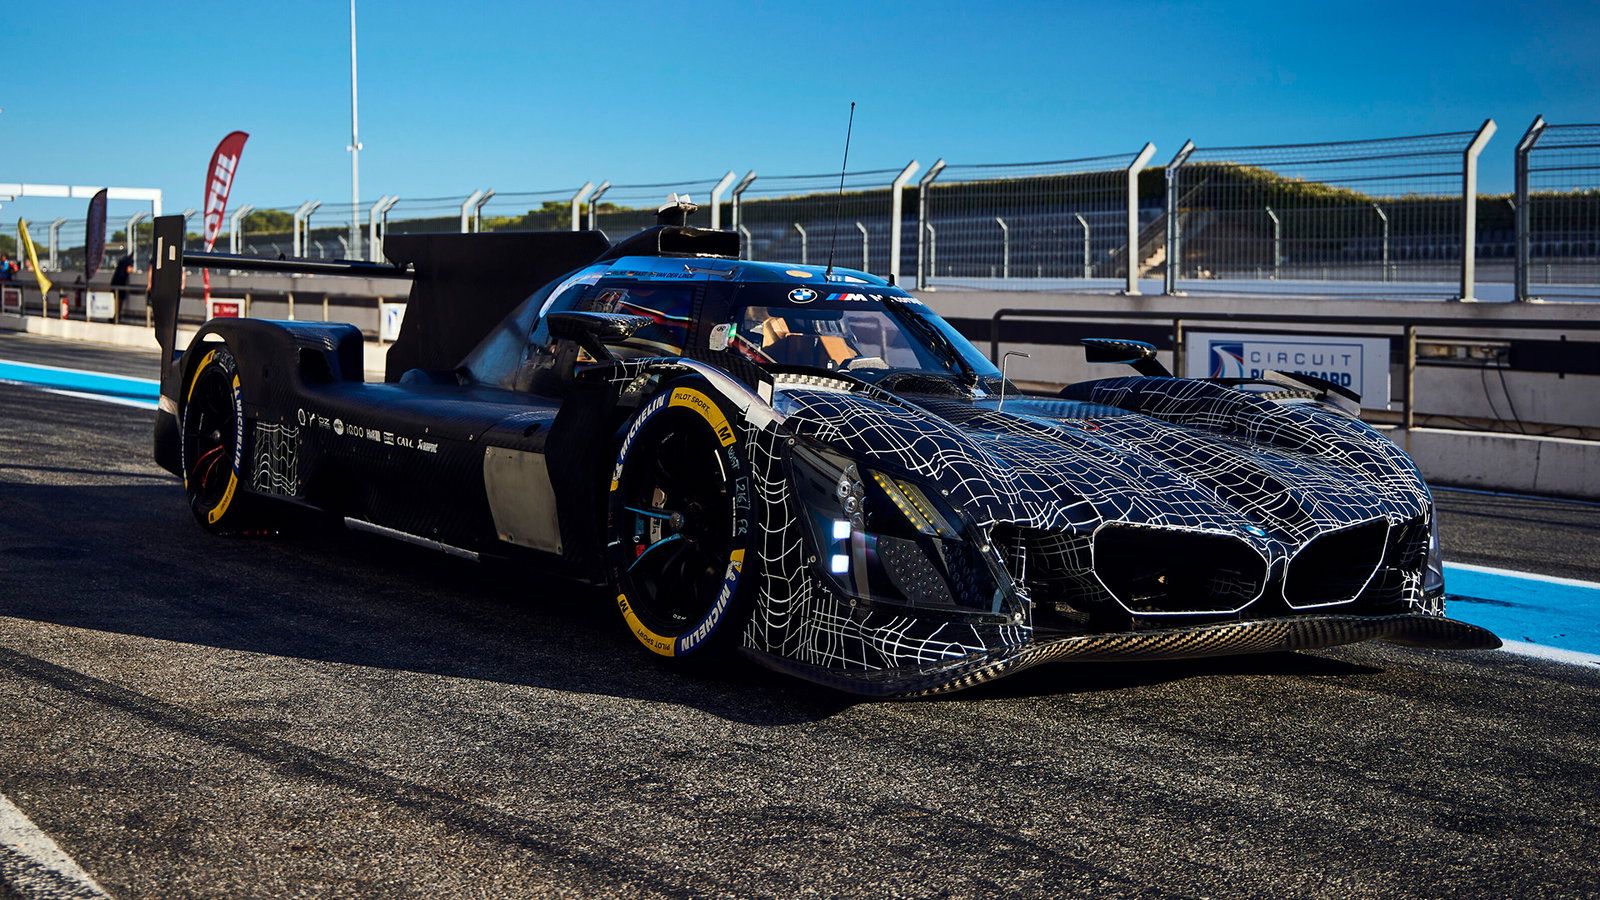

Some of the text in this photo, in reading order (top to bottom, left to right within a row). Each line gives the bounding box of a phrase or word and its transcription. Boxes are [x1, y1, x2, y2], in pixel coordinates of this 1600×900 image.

[1250, 351, 1352, 366] CIRCUIT
[1294, 370, 1352, 387] ARD
[674, 392, 710, 411] PILOT SPORT
[234, 400, 242, 468] MICHELIN
[620, 393, 666, 460] MICHELIN
[717, 425, 733, 442] M
[681, 583, 731, 652] MICHELIN
[637, 628, 671, 651] PILOT SPORT
